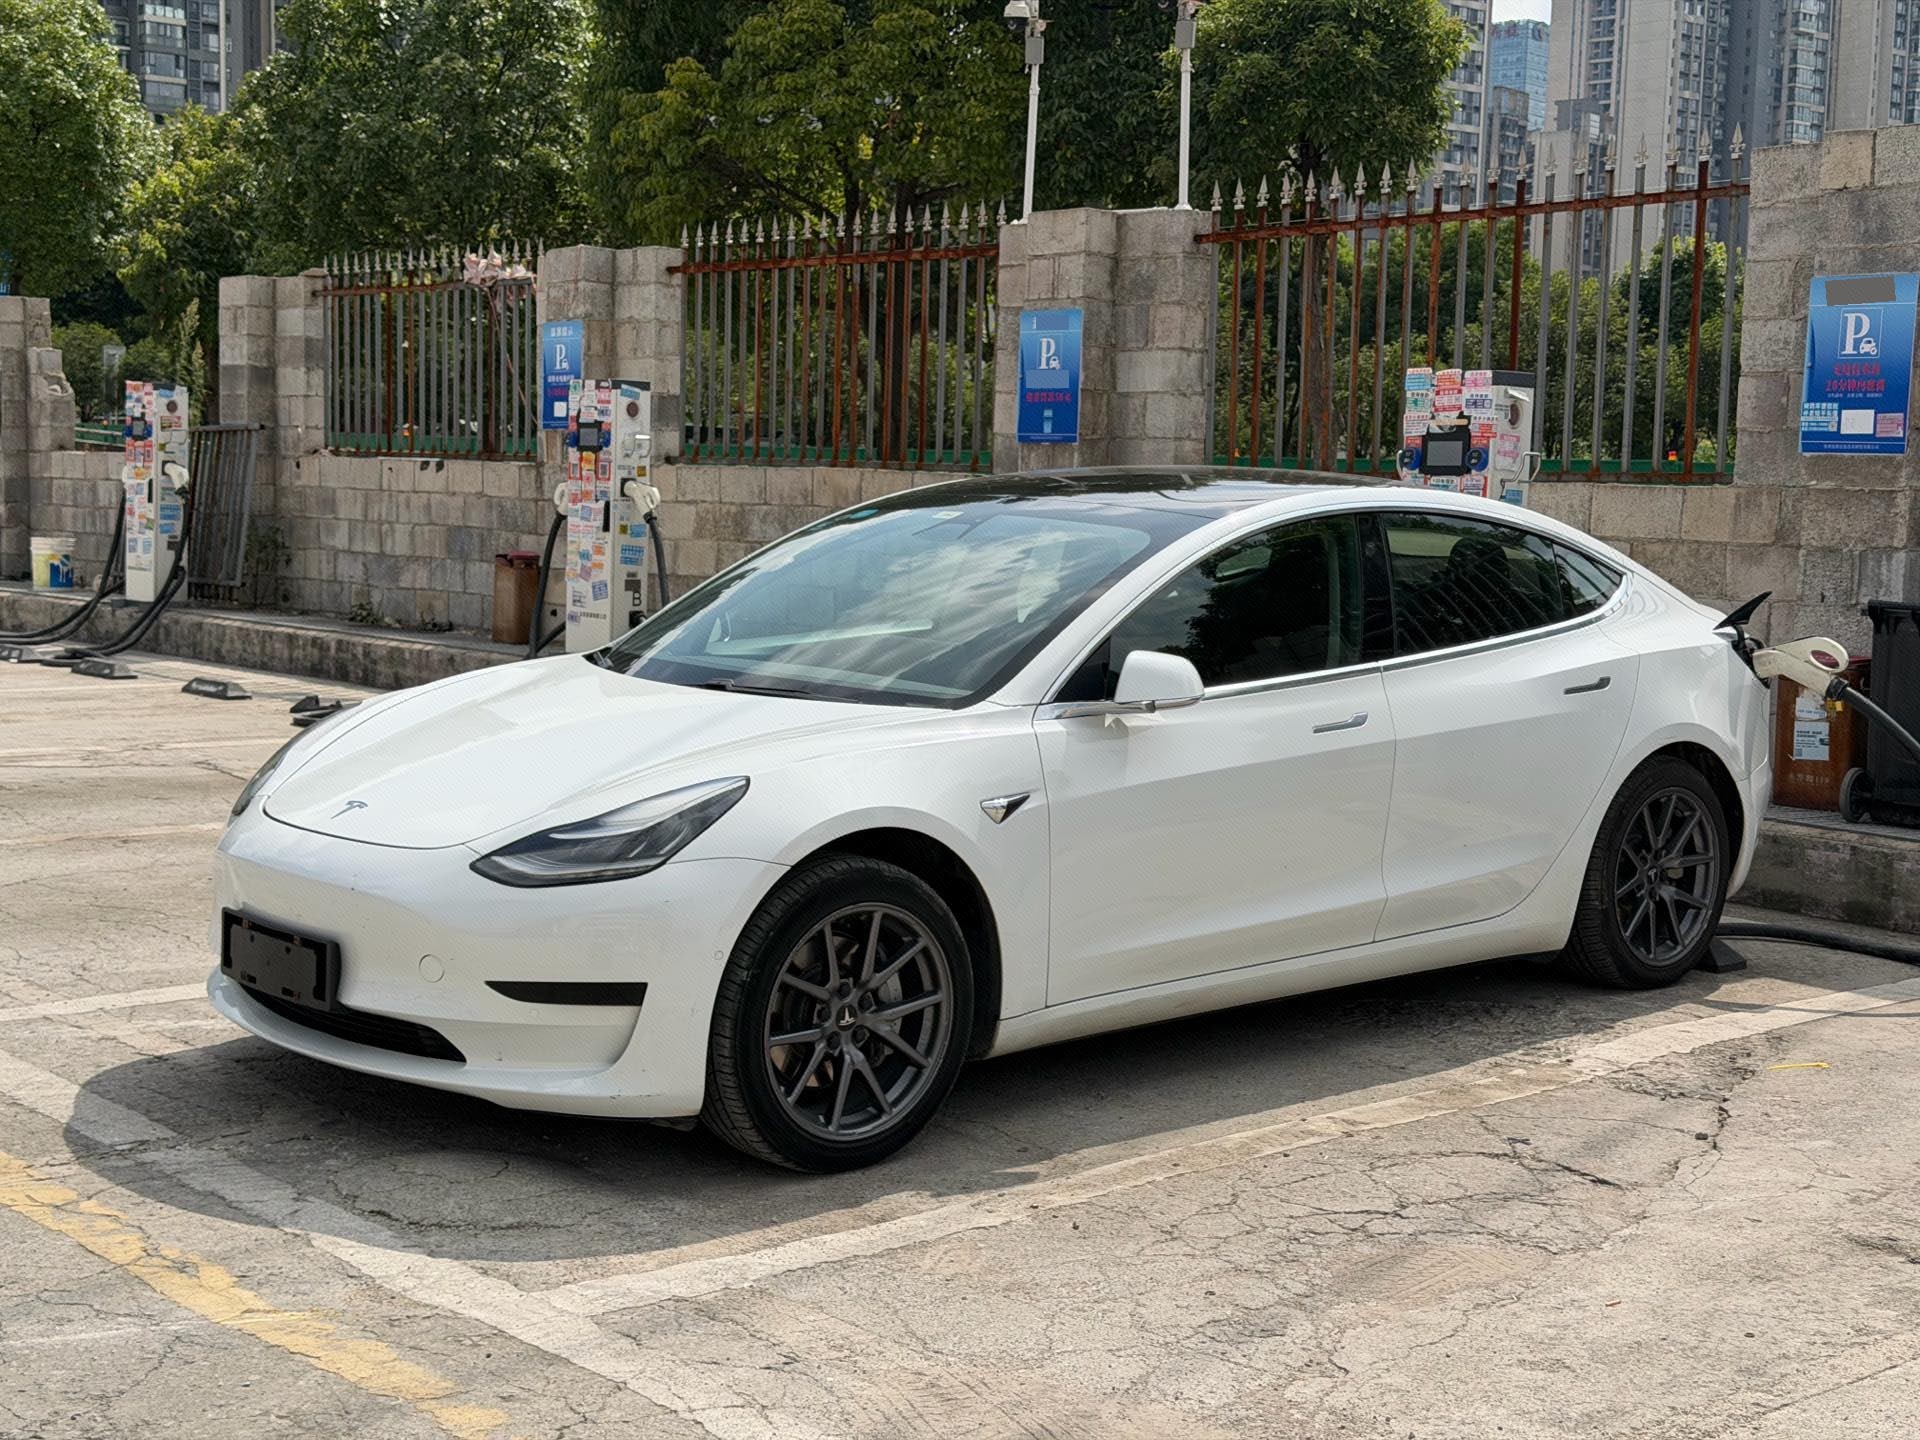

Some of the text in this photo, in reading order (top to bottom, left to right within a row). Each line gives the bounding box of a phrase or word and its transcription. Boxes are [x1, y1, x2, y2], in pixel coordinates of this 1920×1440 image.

[1841, 313, 1870, 354] P
[554, 344, 566, 370] P
[1038, 337, 1055, 370] P
[632, 591, 642, 607] B
